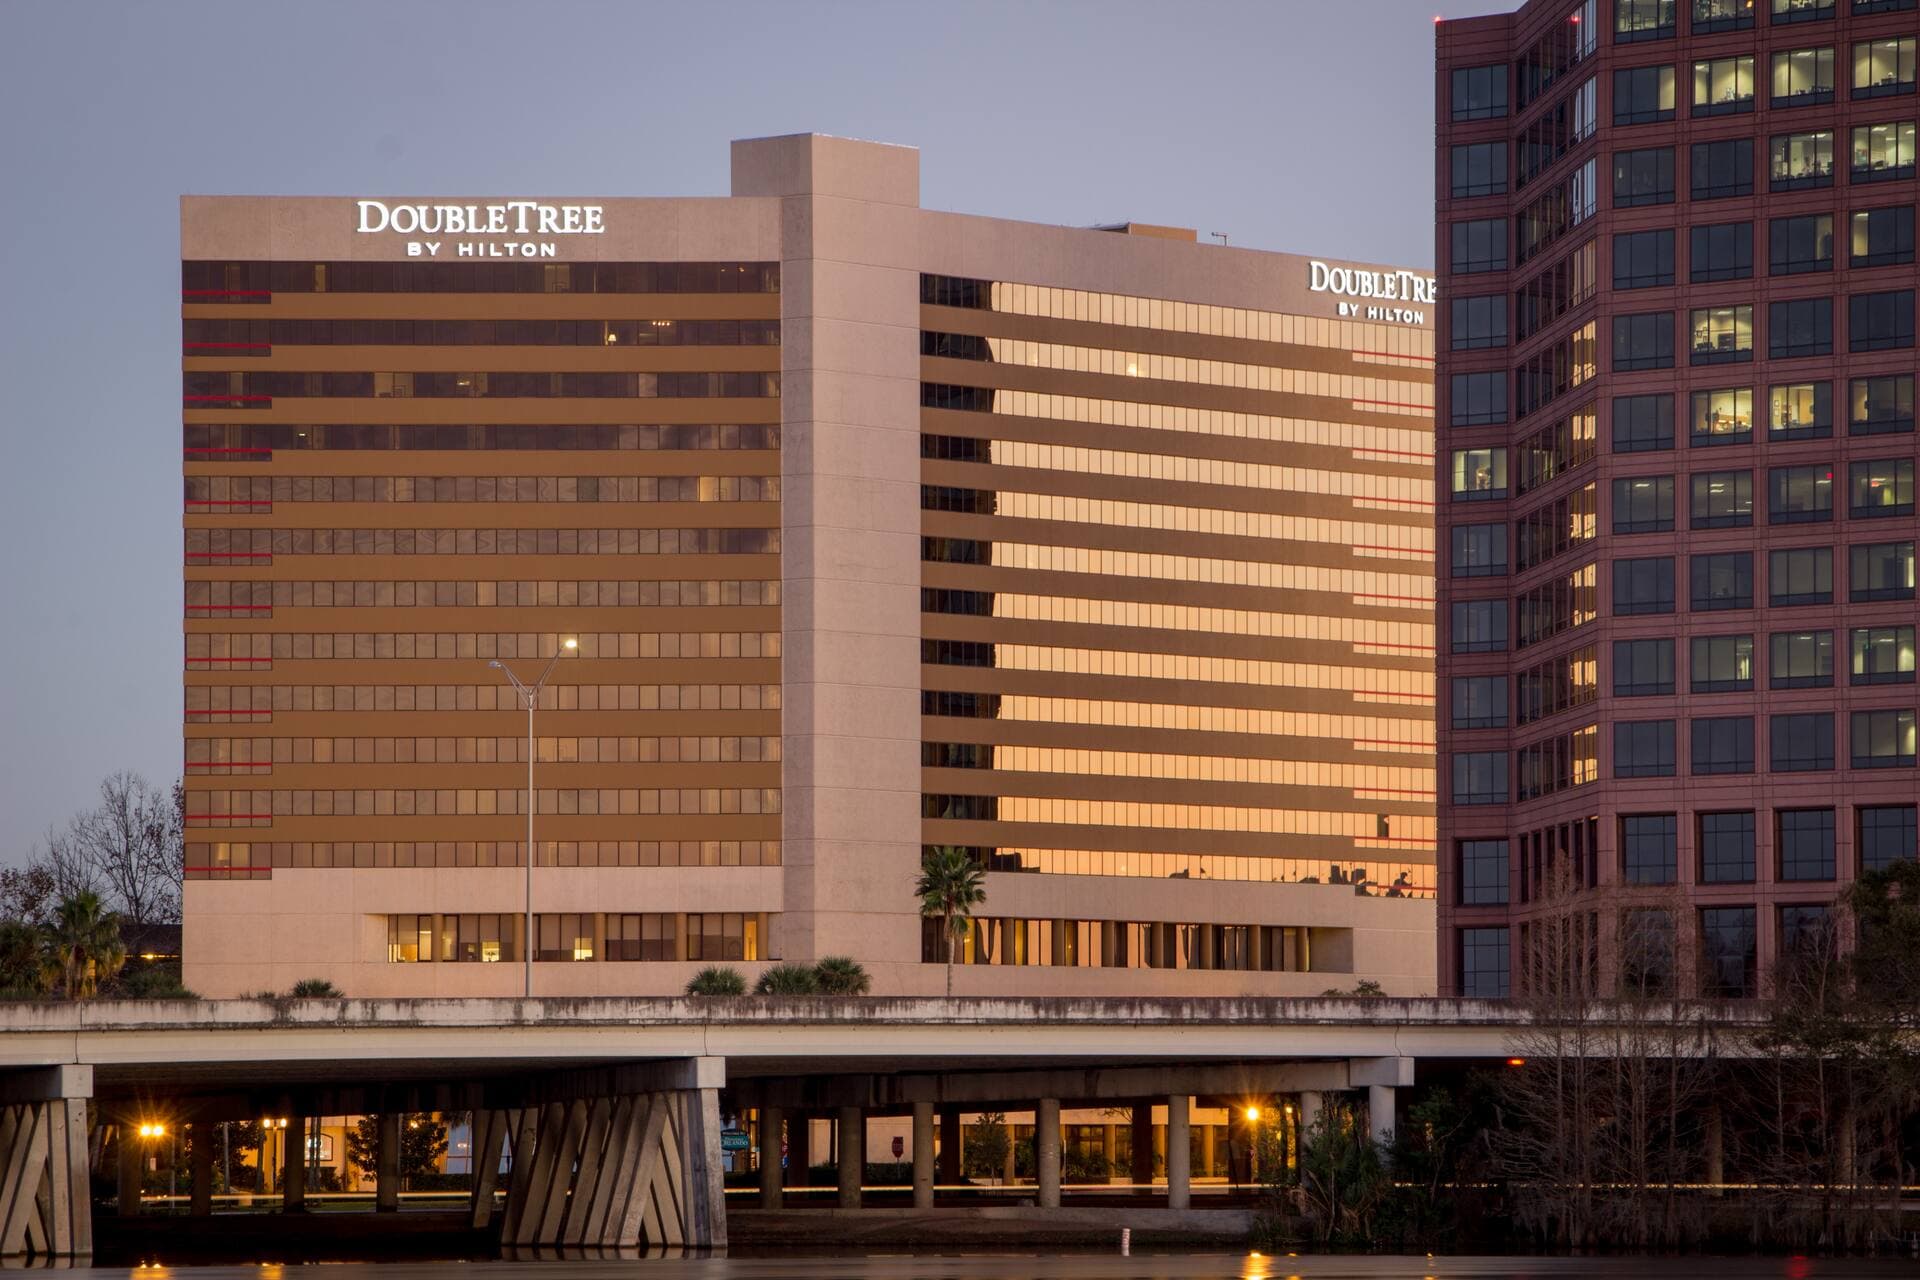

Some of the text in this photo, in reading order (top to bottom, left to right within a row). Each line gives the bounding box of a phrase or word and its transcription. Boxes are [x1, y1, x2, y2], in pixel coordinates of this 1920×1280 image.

[357, 200, 604, 233] DOUBLETREE
[407, 242, 556, 257] BY HILTON
[1310, 261, 1436, 303] DOUBLETRE
[1338, 302, 1423, 324] BY HILTON
